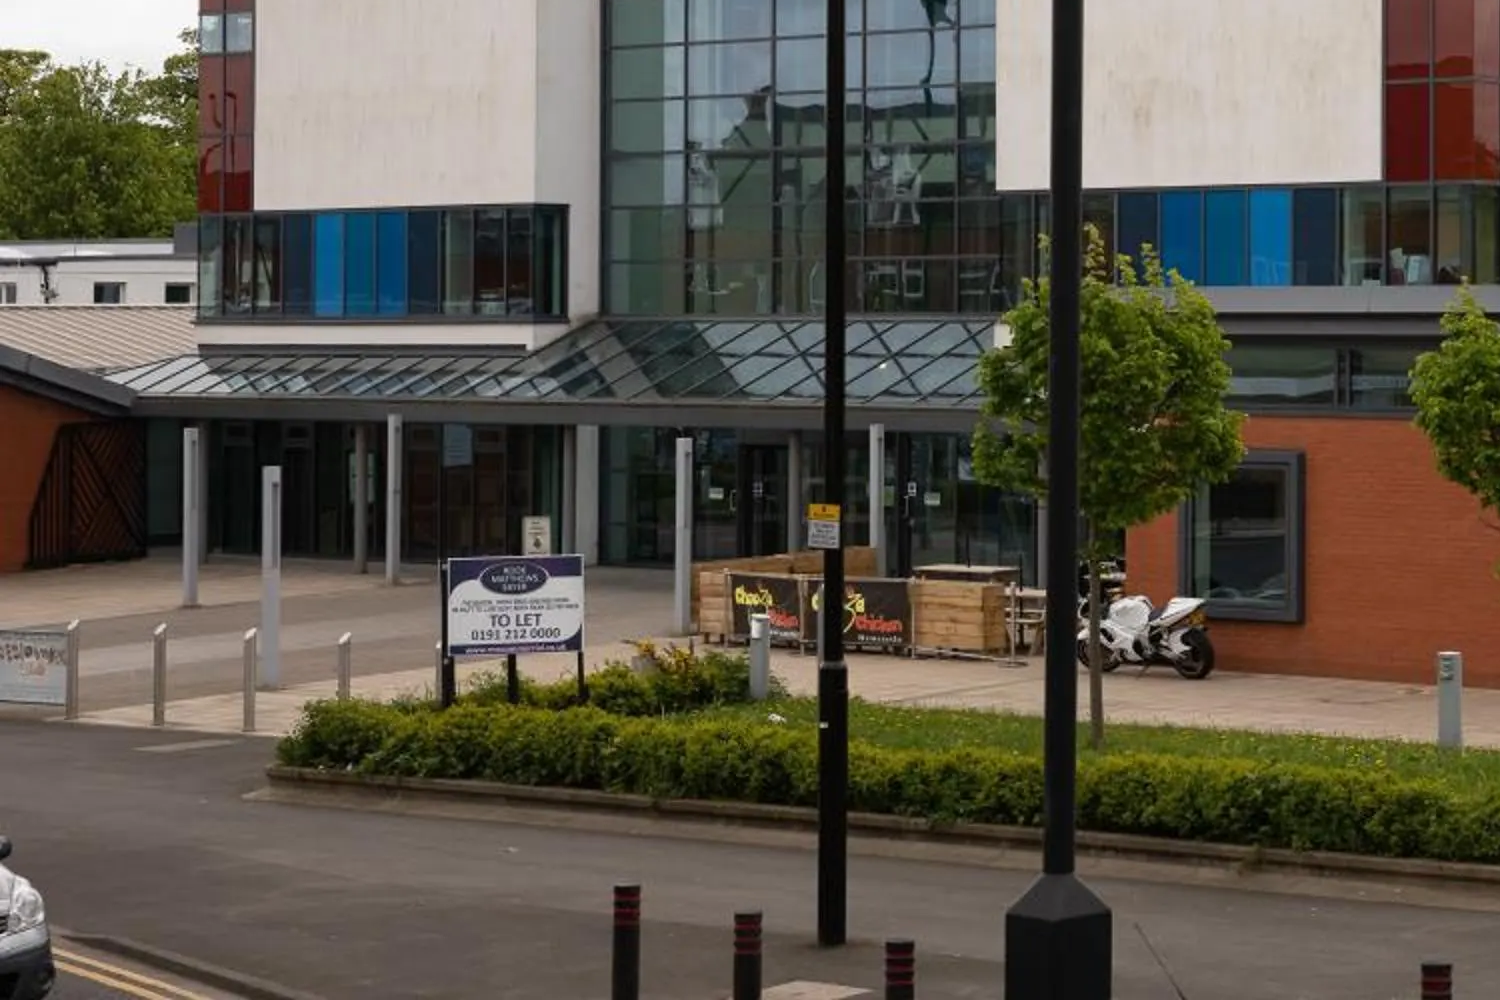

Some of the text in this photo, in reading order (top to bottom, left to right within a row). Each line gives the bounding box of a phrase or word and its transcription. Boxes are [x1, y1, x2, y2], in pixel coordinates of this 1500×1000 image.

[490, 613, 543, 628] TO LET
[471, 627, 561, 640] 0191 212 0000
